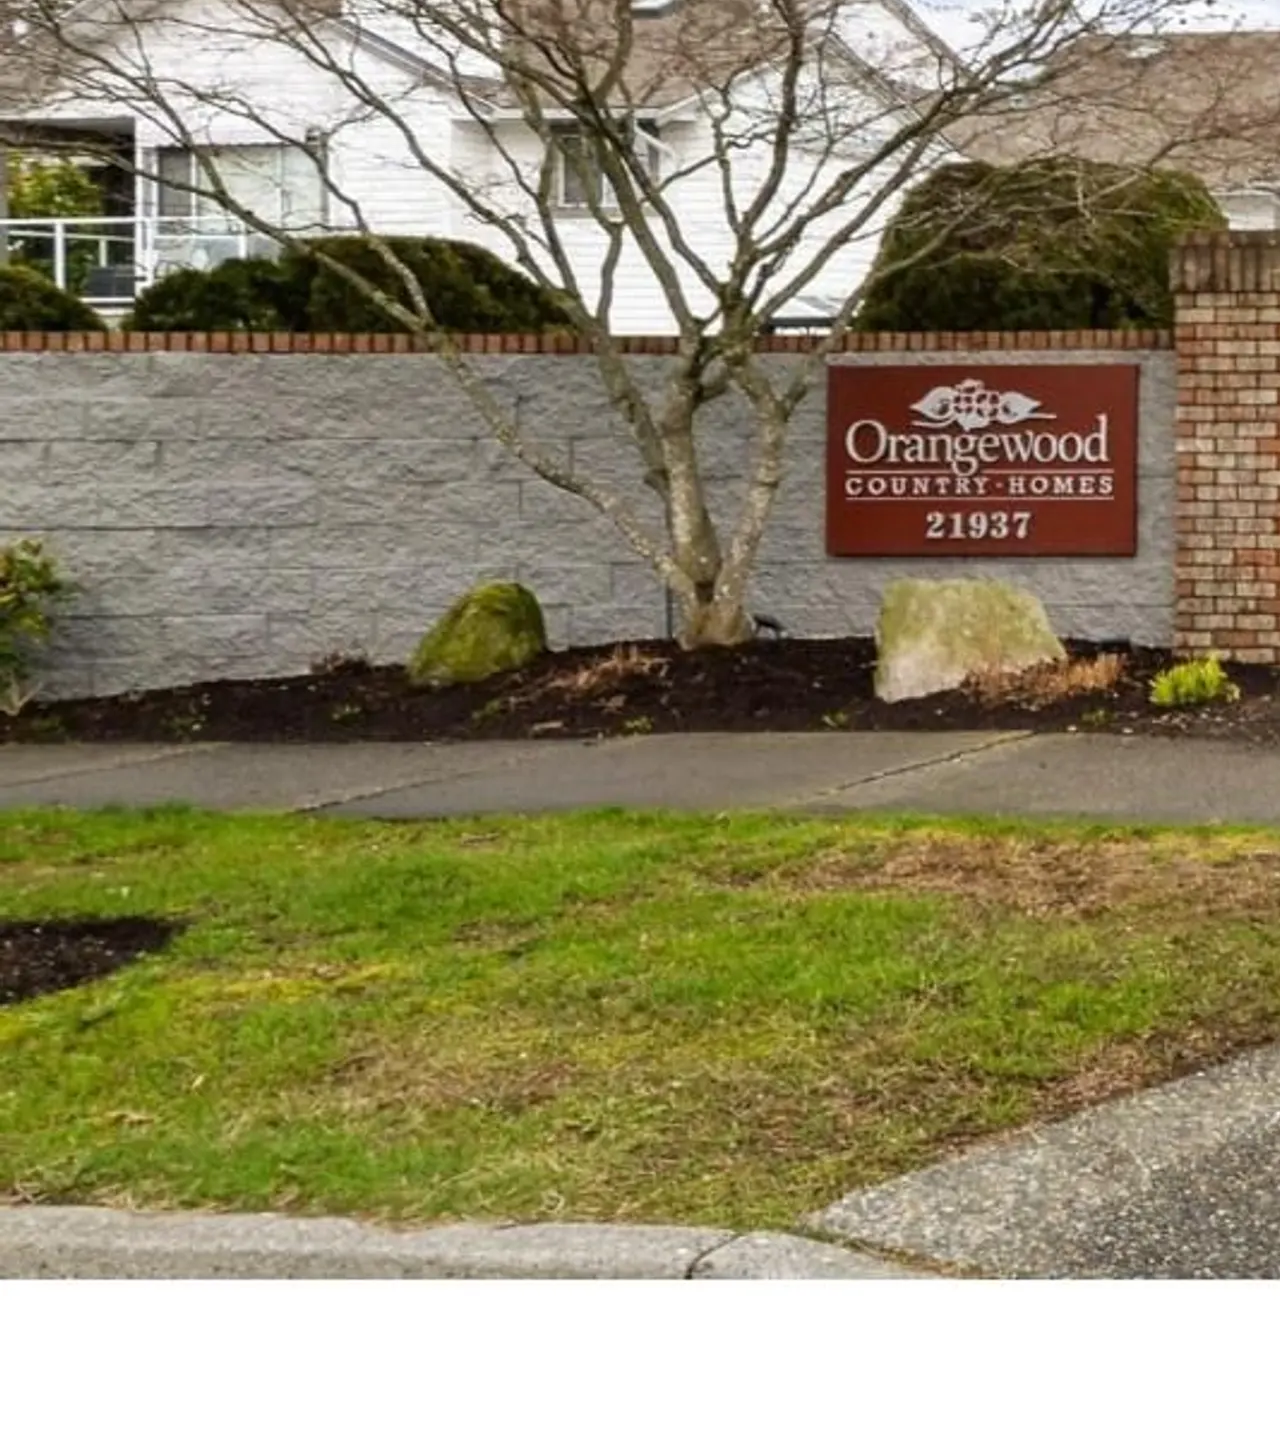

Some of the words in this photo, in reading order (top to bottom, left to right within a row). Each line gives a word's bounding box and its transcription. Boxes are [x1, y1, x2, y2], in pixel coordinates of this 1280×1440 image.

[846, 414, 1109, 476] Orangewood
[845, 475, 990, 495] COUNTRY
[1010, 475, 1113, 495] HOMES
[926, 511, 1032, 539] 21937
